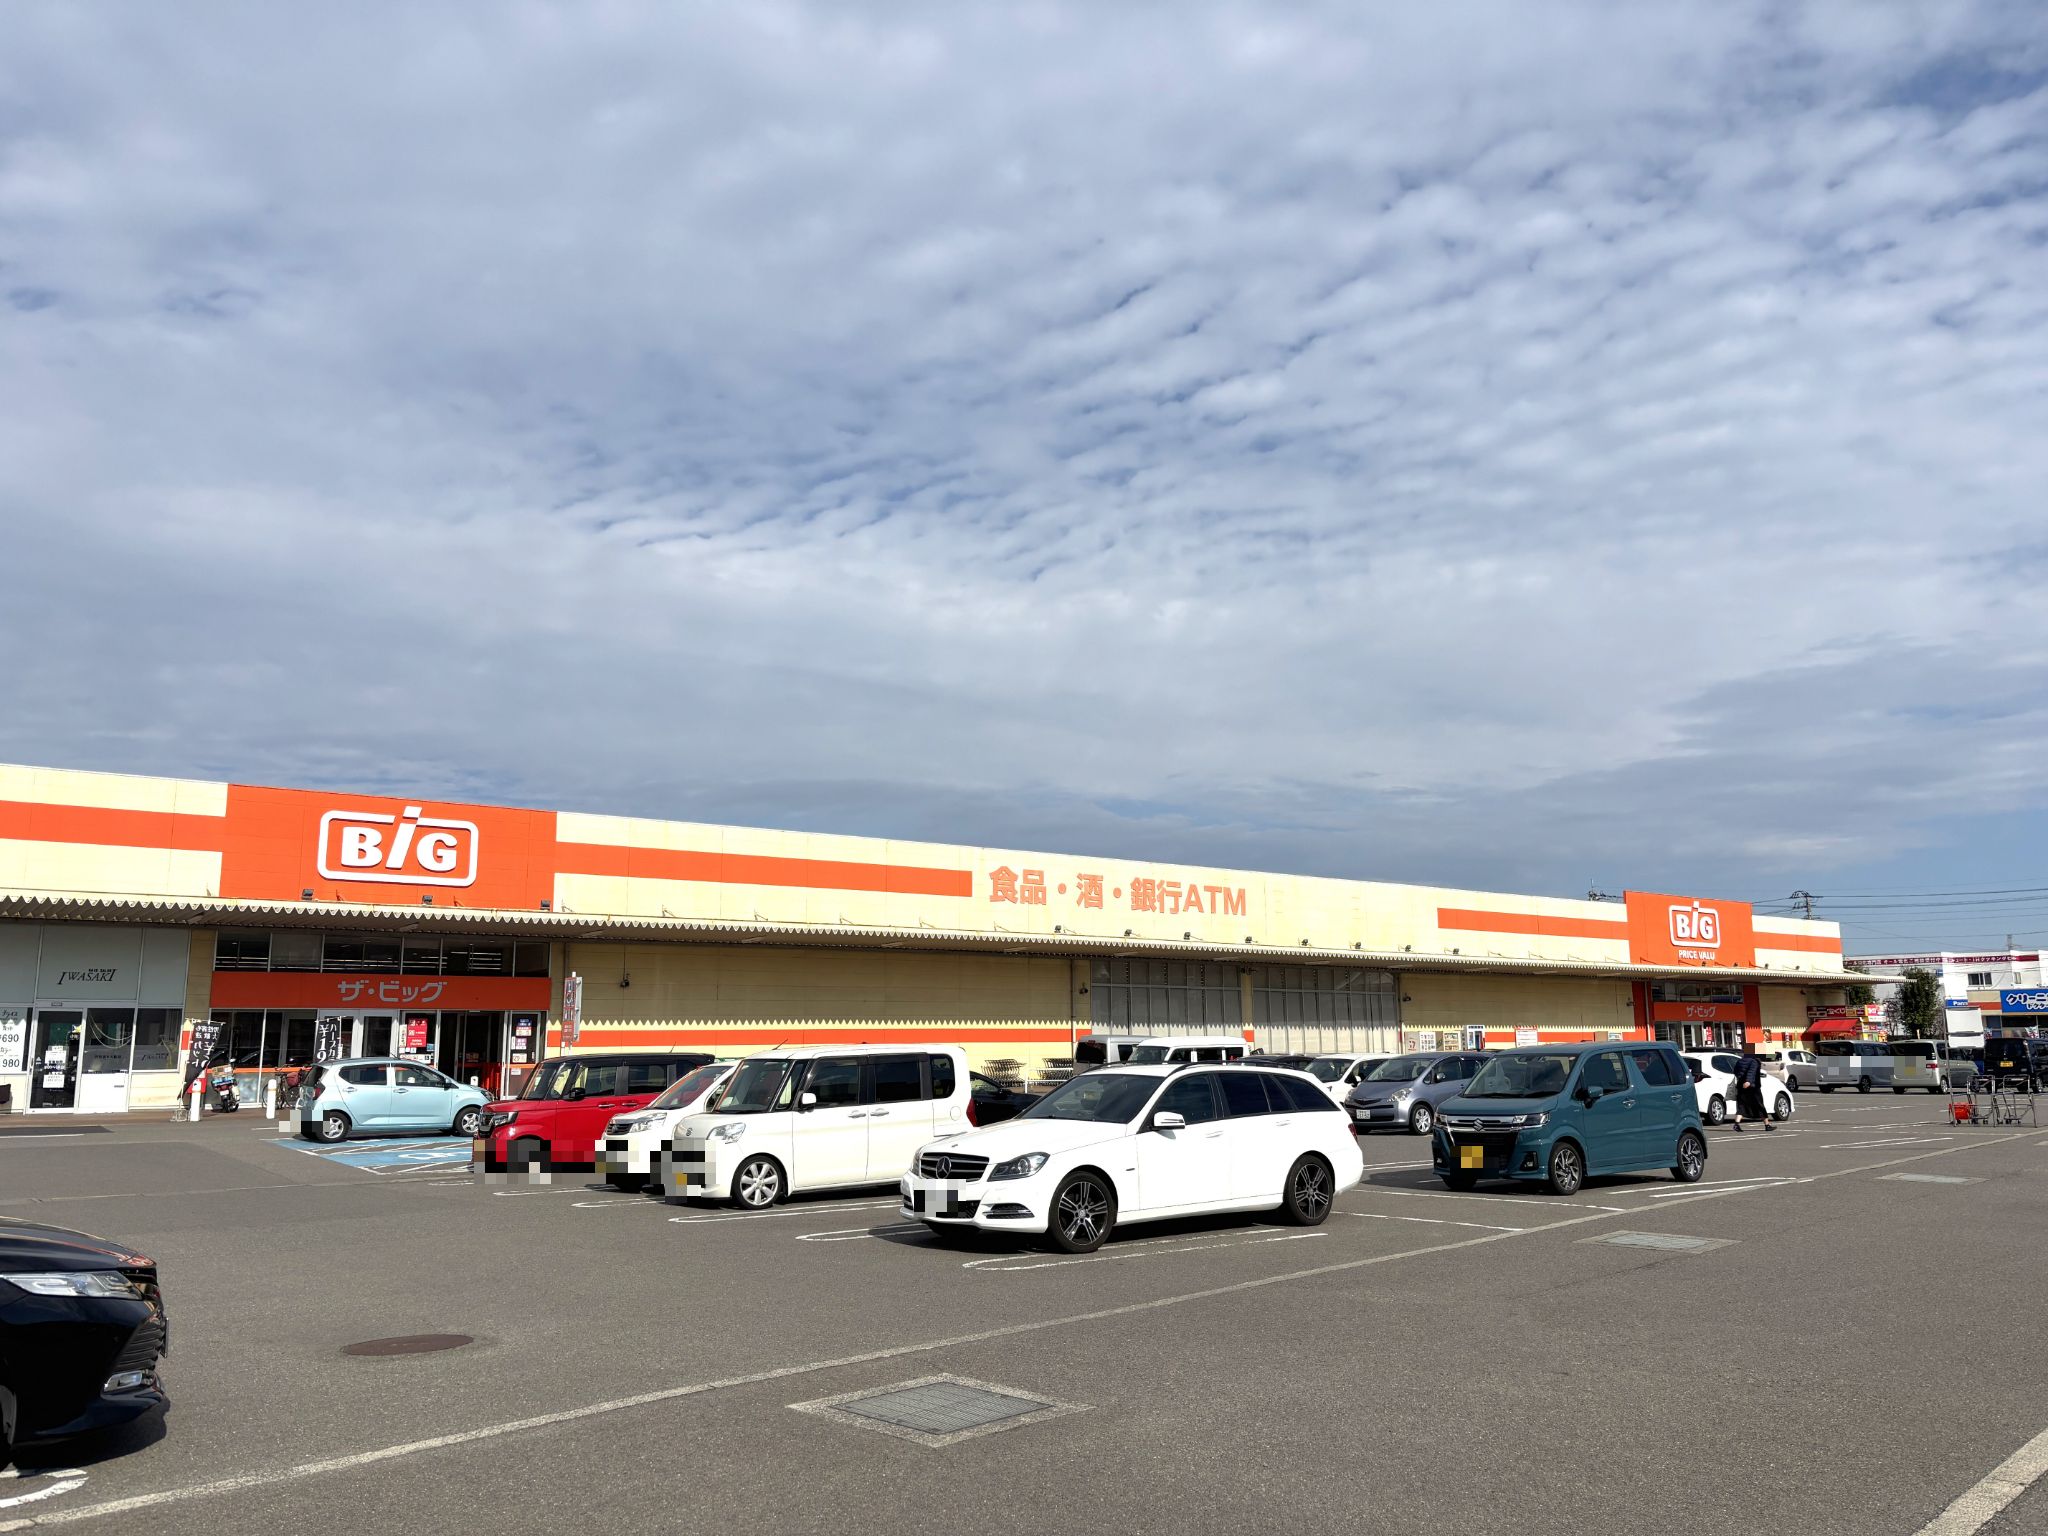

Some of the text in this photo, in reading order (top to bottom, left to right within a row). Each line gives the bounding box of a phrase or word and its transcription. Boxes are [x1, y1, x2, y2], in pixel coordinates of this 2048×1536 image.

[989, 866, 1246, 916] 食品・酒・銀行ATM
[1678, 949, 1698, 959] PRICE
[57, 968, 118, 985] IWASAKI
[337, 978, 448, 1003] ザ・ビッグ
[2006, 993, 2048, 1005] クリーニ
[1686, 1005, 1717, 1018] ザ・ビッグ
